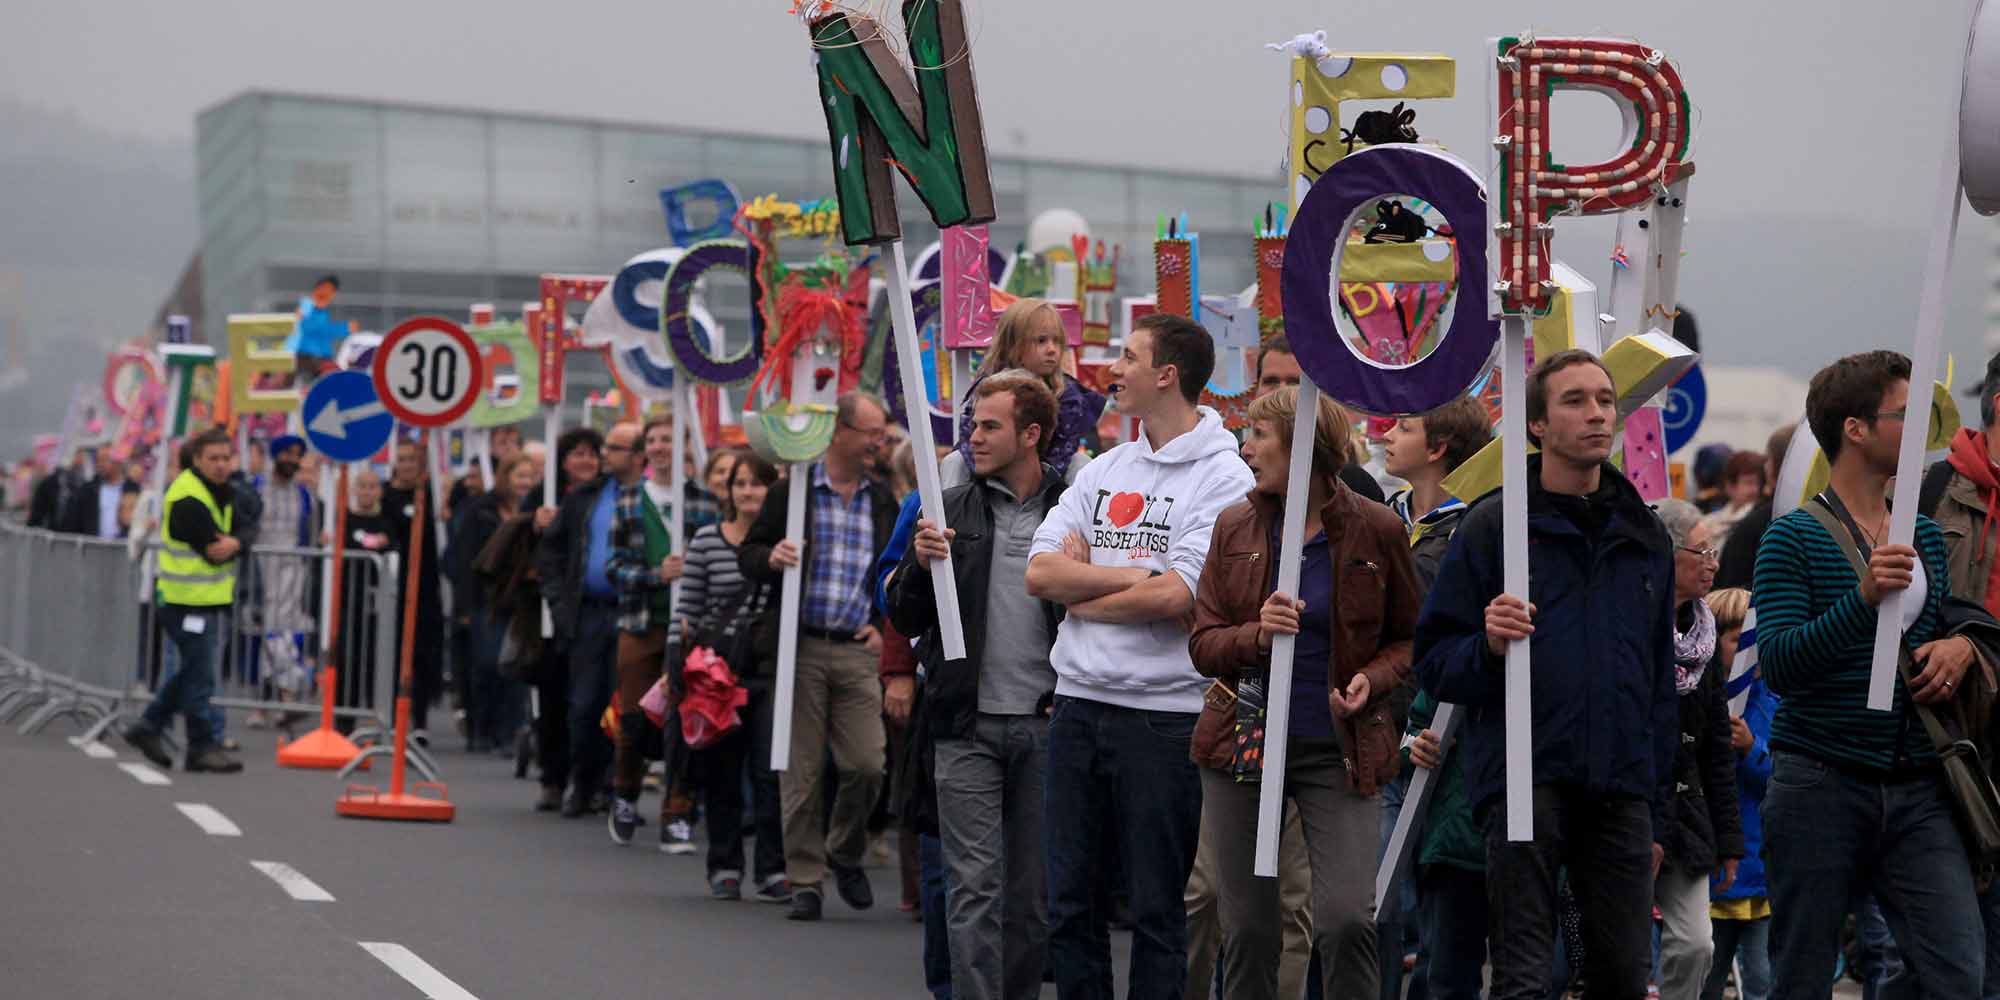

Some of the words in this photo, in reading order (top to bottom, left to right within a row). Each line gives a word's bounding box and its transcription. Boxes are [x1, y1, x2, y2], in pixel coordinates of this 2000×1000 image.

[812, 0, 994, 246] N
[1493, 36, 1690, 317] P
[1281, 142, 1501, 415] O
[158, 344, 215, 439] T
[228, 313, 301, 415] E
[399, 343, 456, 401] 30
[1093, 489, 1111, 526] I
